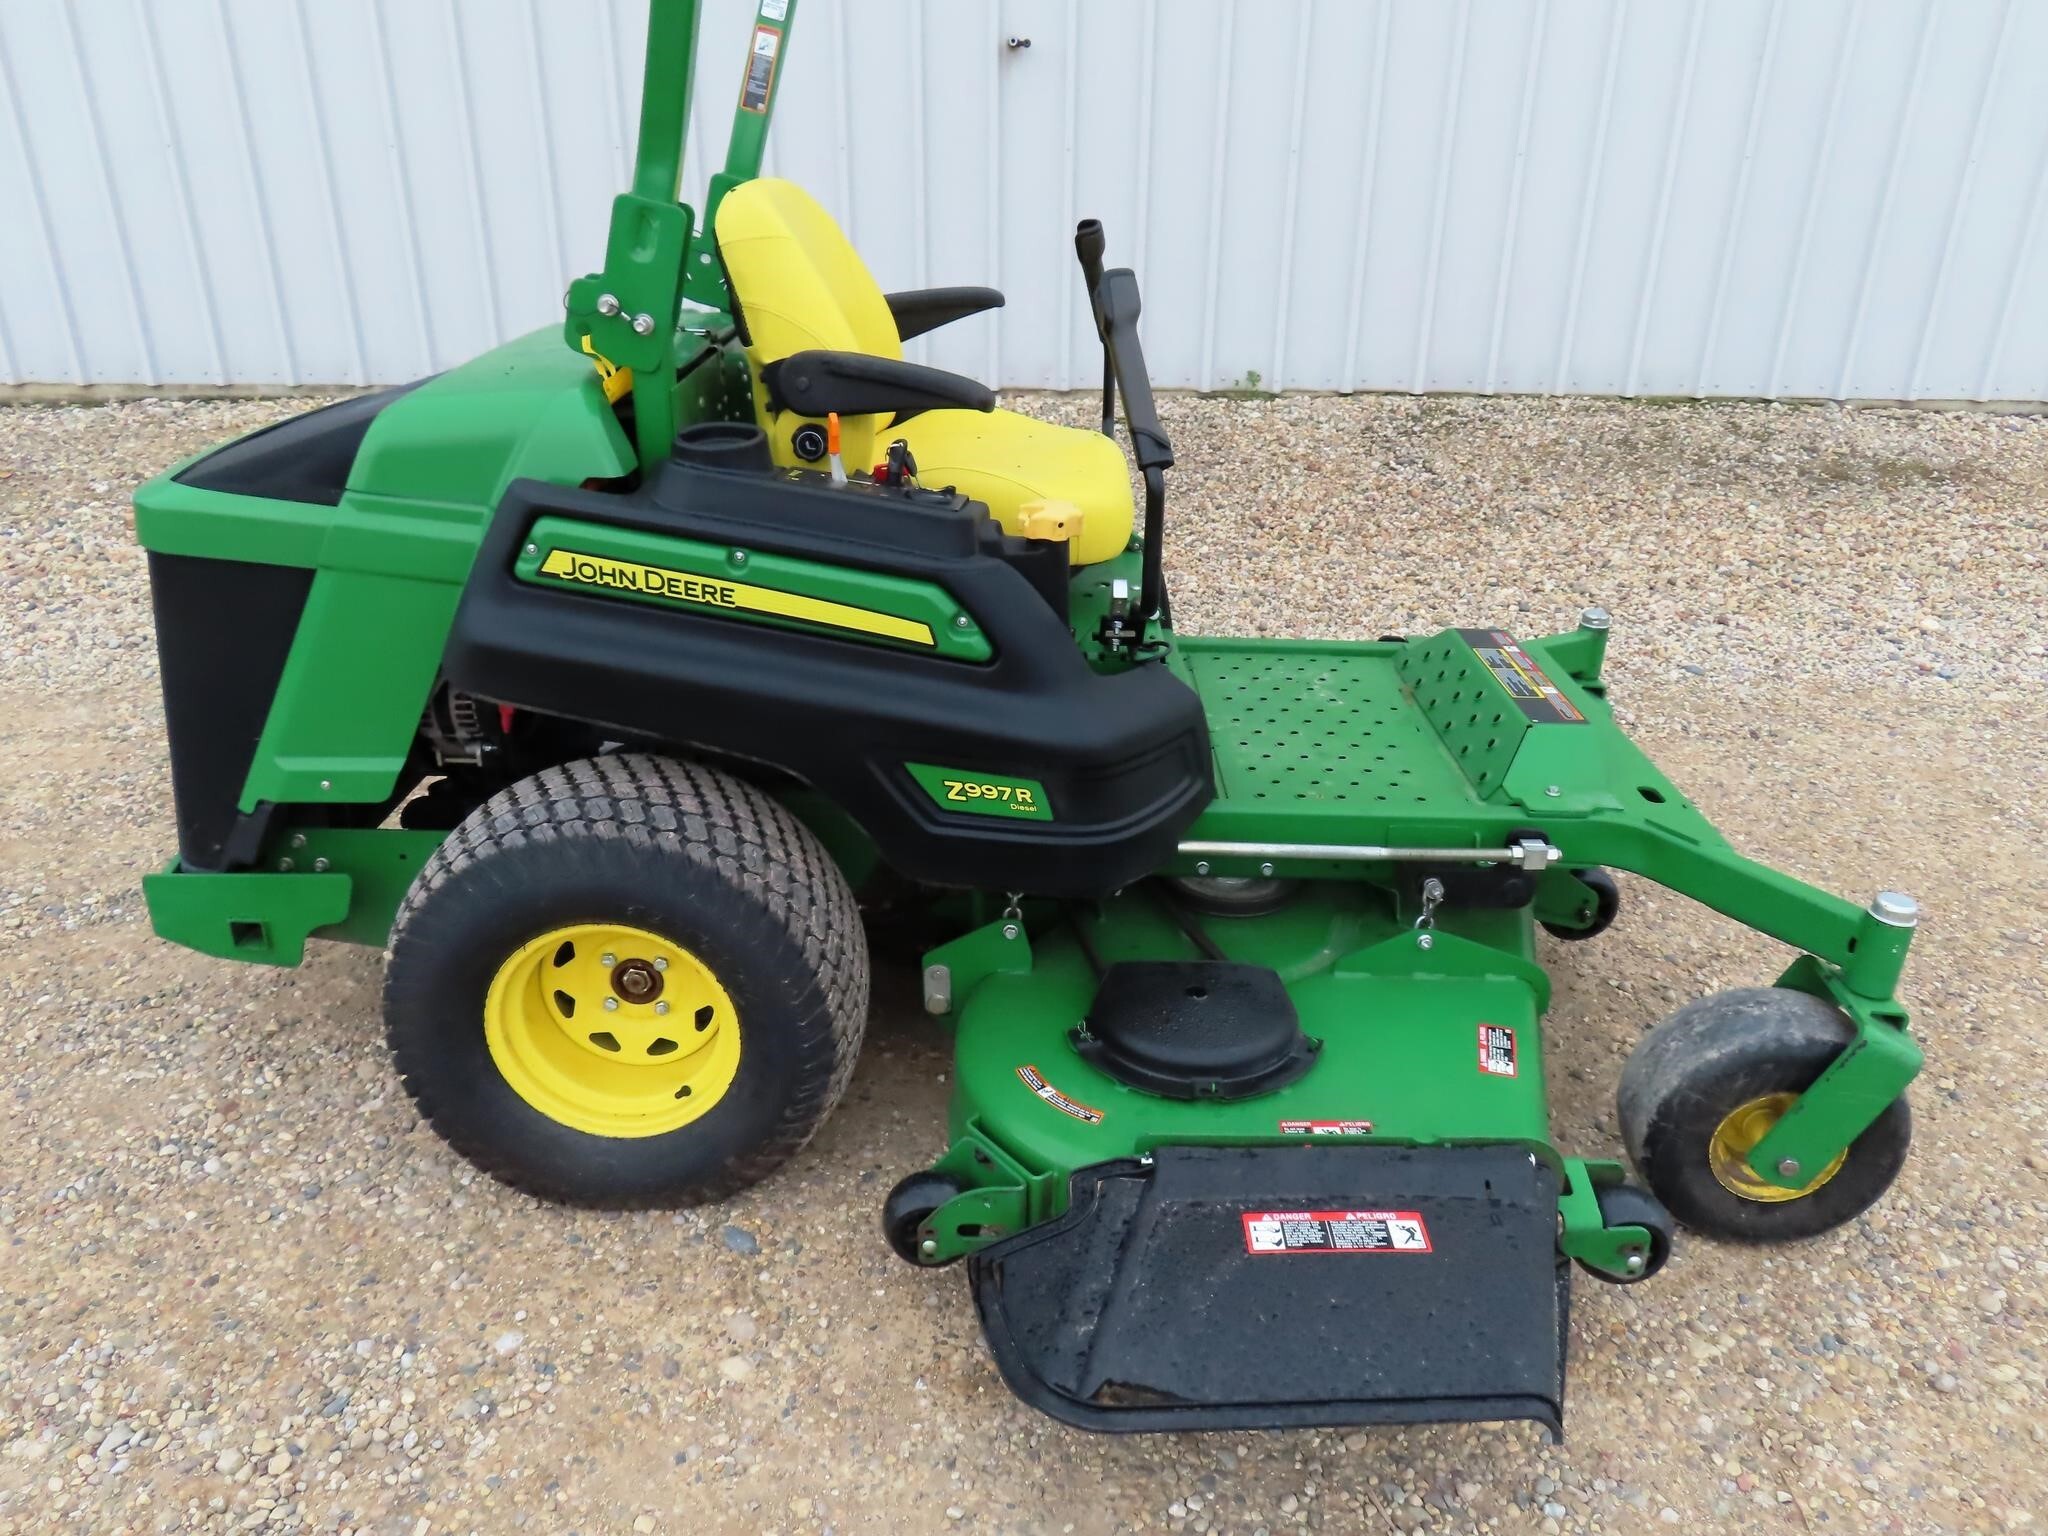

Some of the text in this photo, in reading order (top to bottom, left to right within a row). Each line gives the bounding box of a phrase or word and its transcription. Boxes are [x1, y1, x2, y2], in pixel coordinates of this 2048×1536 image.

[563, 557, 736, 604] JOHN DEERE
[1010, 803, 1037, 812] Diesel
[1355, 1212, 1397, 1220] PELIGRO
